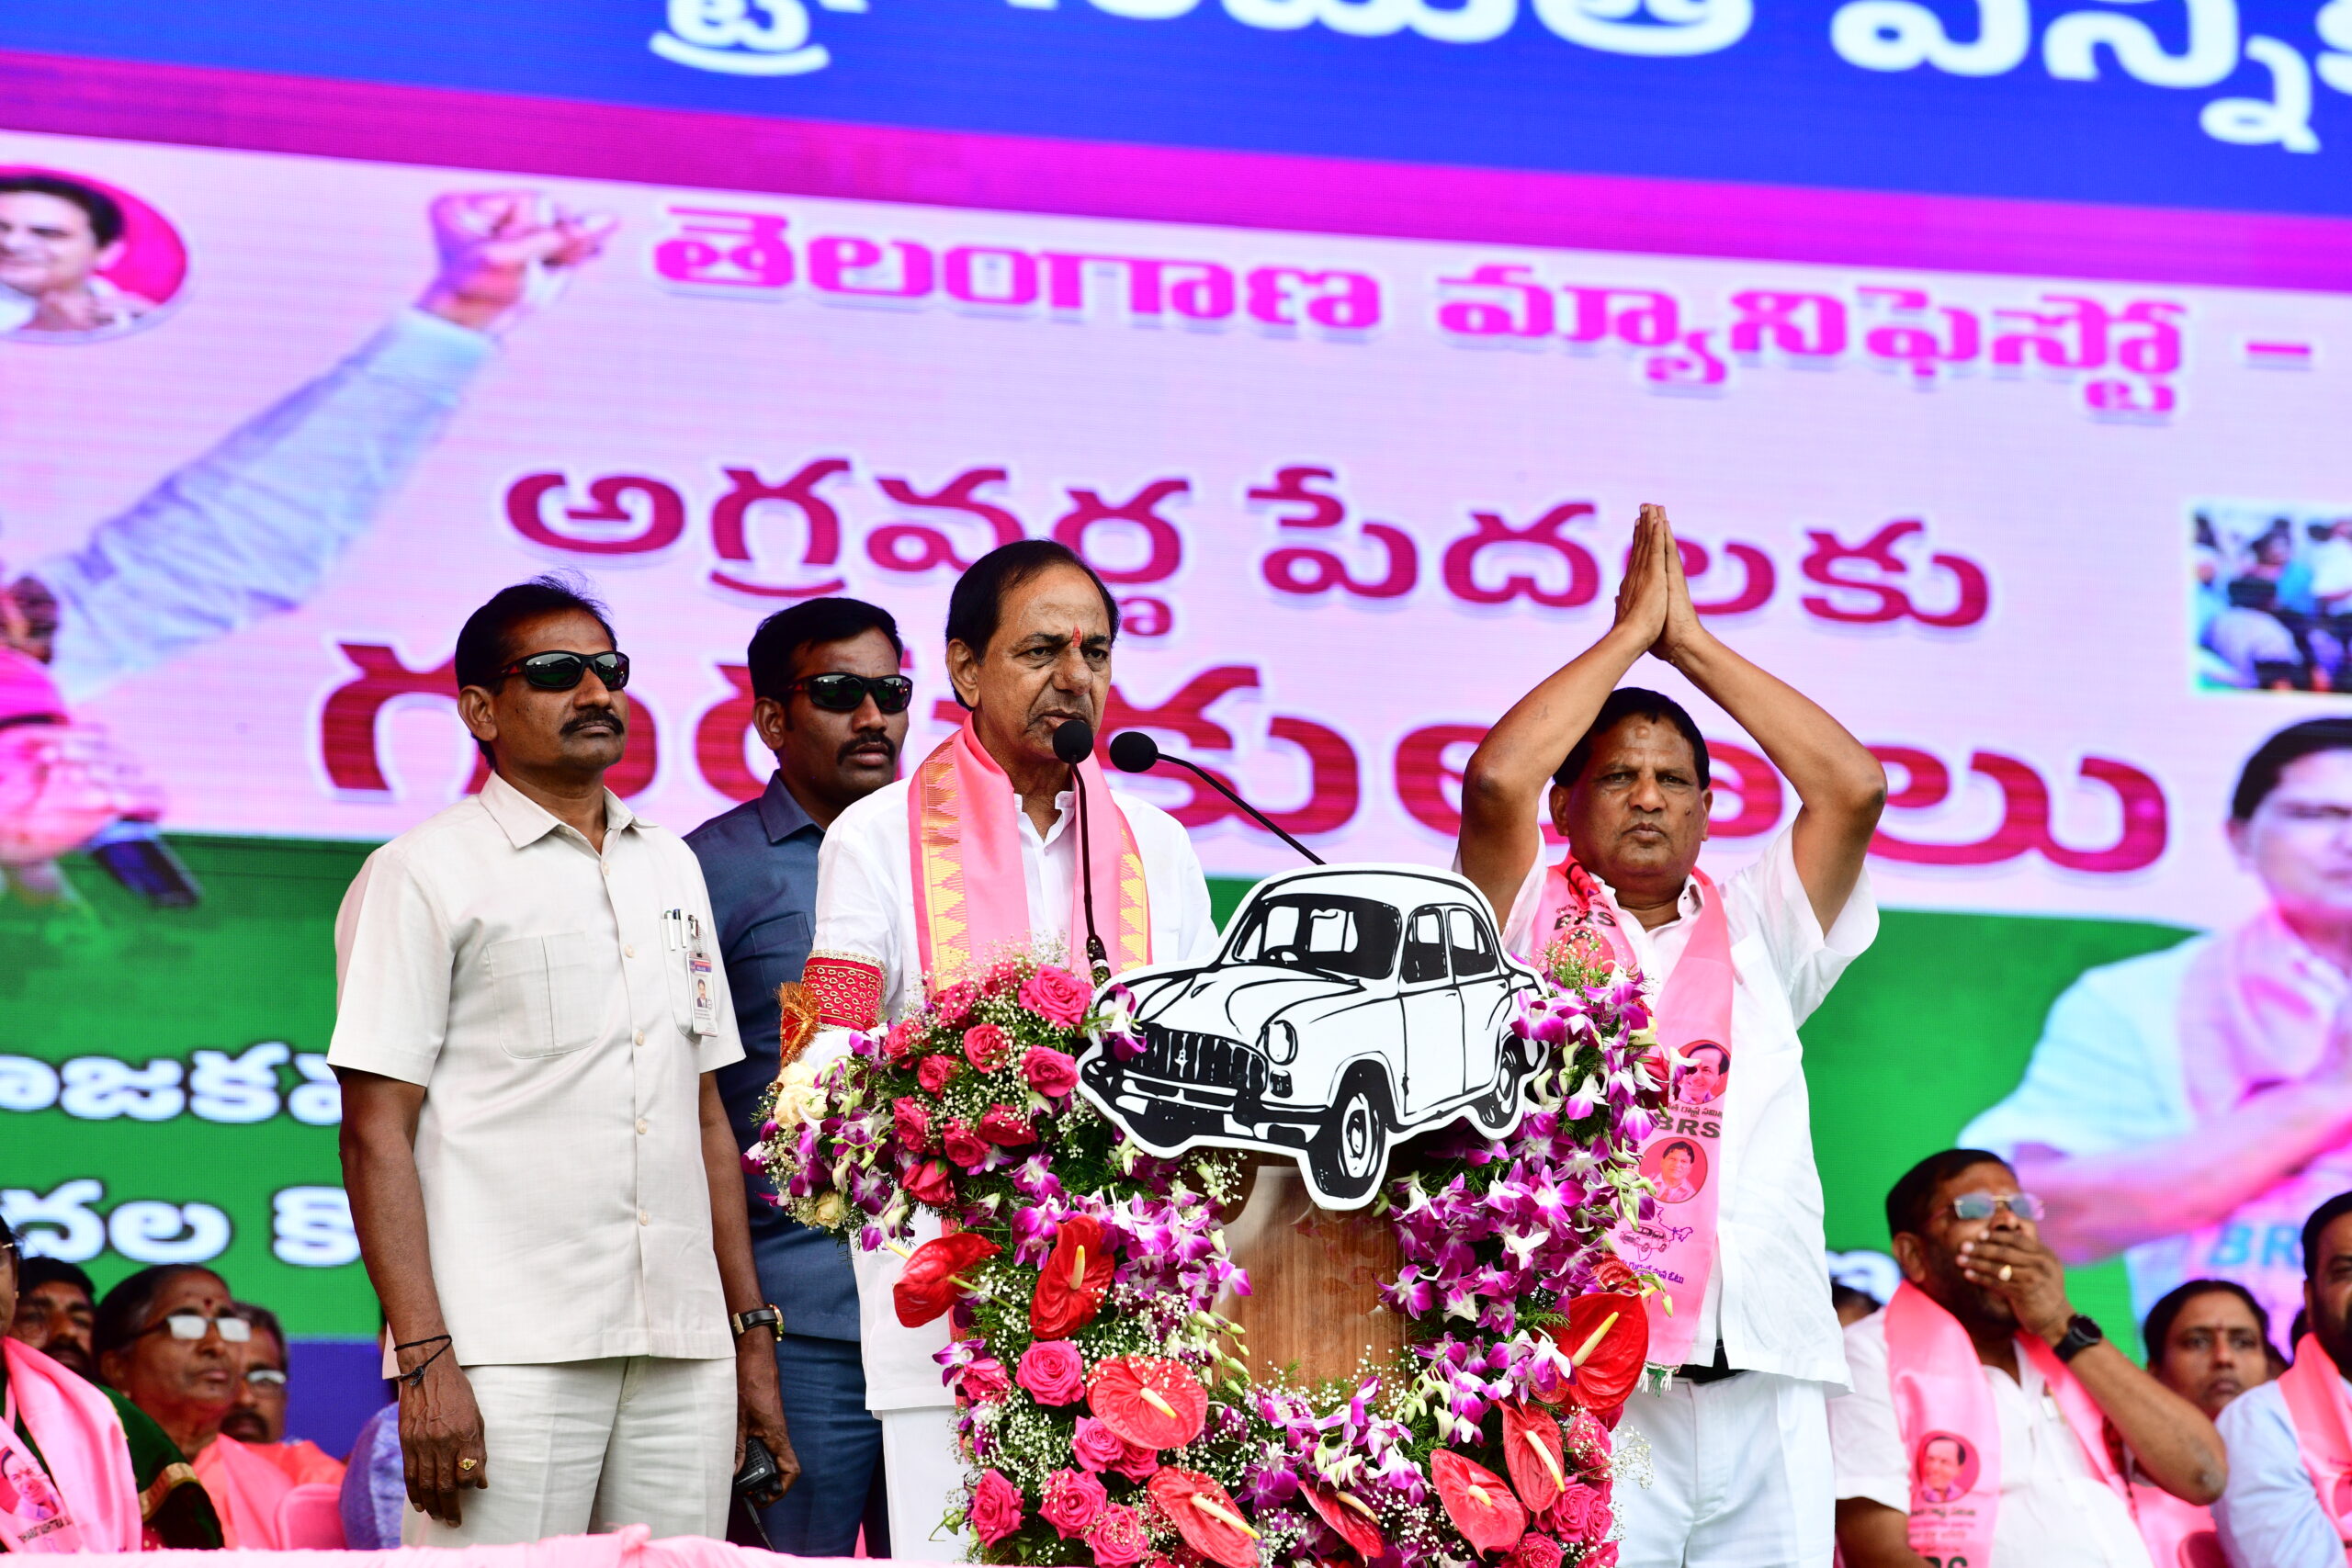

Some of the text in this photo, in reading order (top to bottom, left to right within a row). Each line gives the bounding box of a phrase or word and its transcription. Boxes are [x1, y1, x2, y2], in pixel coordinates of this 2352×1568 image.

[654, 207, 1380, 331] తెలంగాణ
[1248, 467, 1989, 627] పేదలకు
[1654, 1112, 1721, 1138] BRS
[2210, 1224, 2303, 1268] BR
